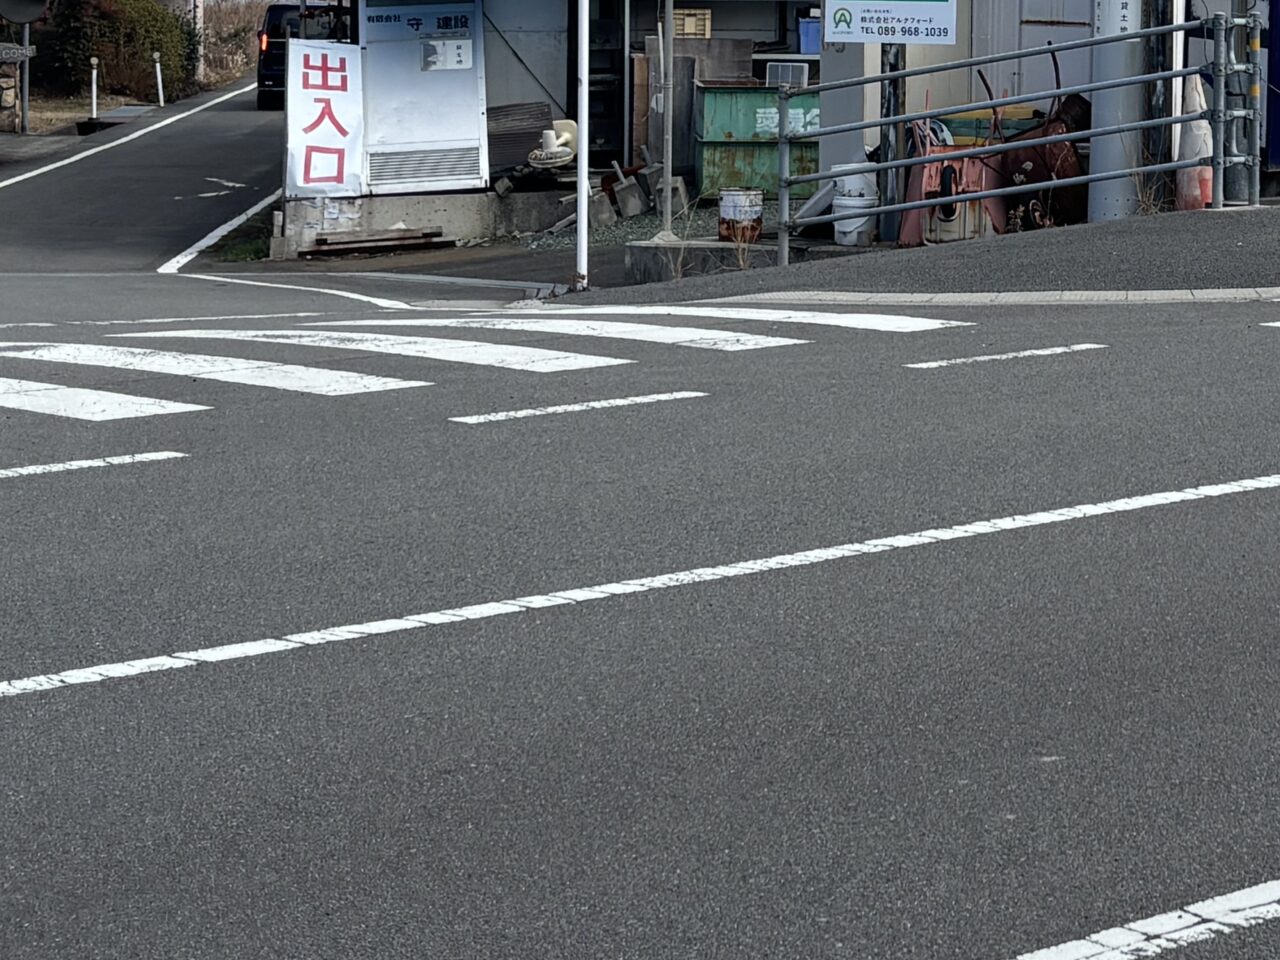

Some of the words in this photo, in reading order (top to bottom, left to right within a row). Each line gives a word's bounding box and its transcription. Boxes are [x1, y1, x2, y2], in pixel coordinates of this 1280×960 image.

[406, 17, 423, 31] 守
[437, 15, 469, 30] 建設
[861, 26, 875, 34] TEL
[877, 26, 949, 37] 089-968-1039
[302, 53, 349, 185] 出入口
